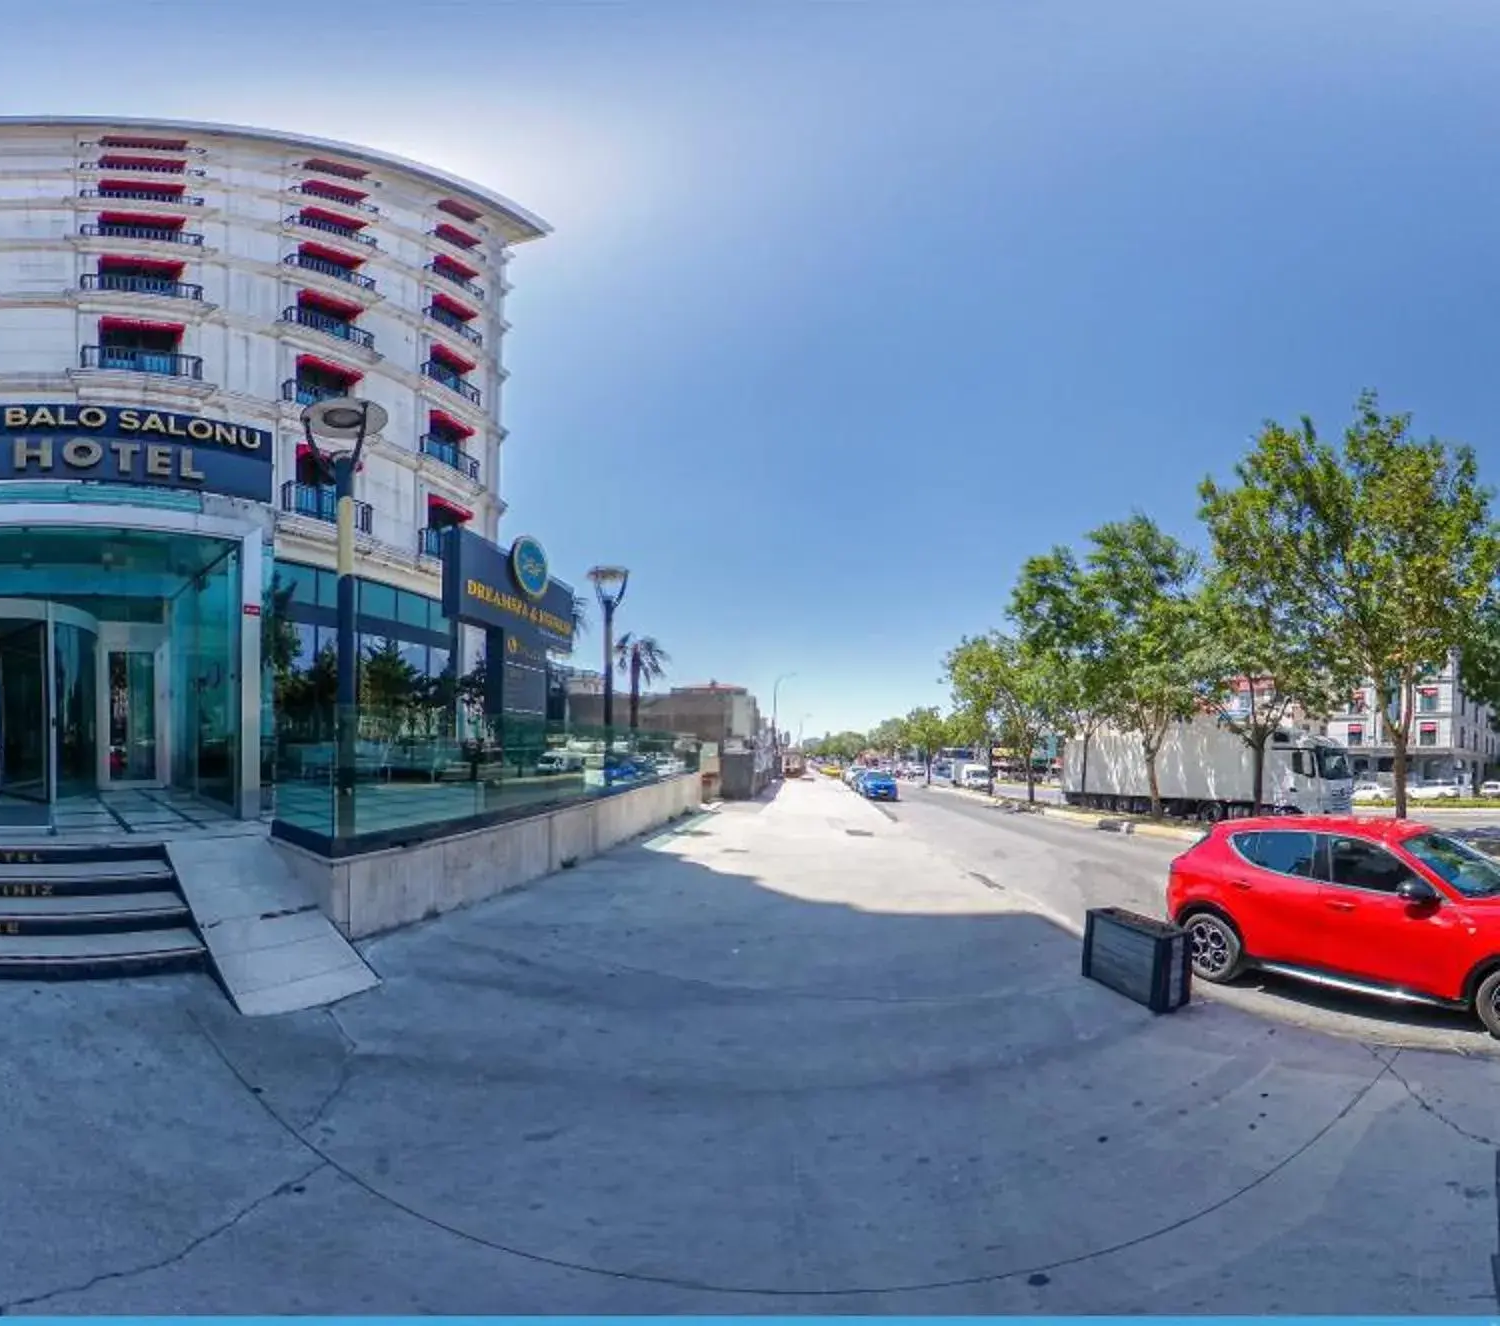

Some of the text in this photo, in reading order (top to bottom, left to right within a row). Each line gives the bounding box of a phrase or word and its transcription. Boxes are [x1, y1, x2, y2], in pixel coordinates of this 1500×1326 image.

[5, 405, 108, 429] BALO
[118, 410, 262, 450] SALONU
[13, 436, 206, 480] HOTEL
